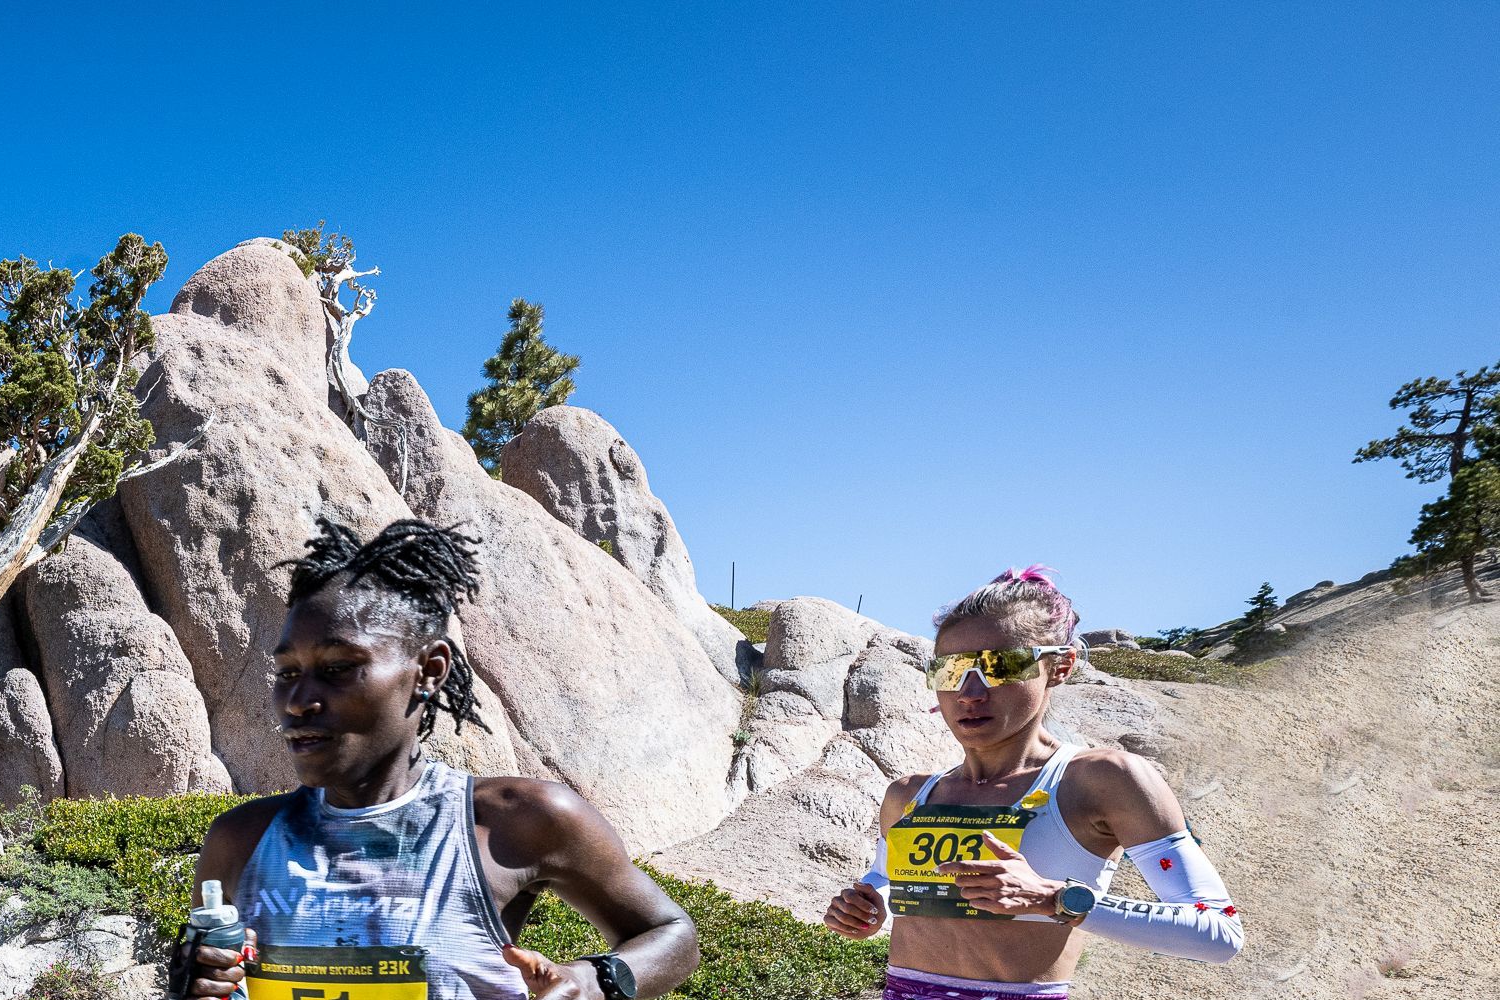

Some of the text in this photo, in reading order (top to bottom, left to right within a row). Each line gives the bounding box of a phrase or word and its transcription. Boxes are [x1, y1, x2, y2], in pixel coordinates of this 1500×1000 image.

[936, 816, 961, 824] ARROW
[962, 817, 993, 825] SKYRACE
[995, 814, 1020, 824] 23K
[909, 833, 984, 866] 303
[260, 960, 410, 976] BROKEN ARROW SKYRACE 23K
